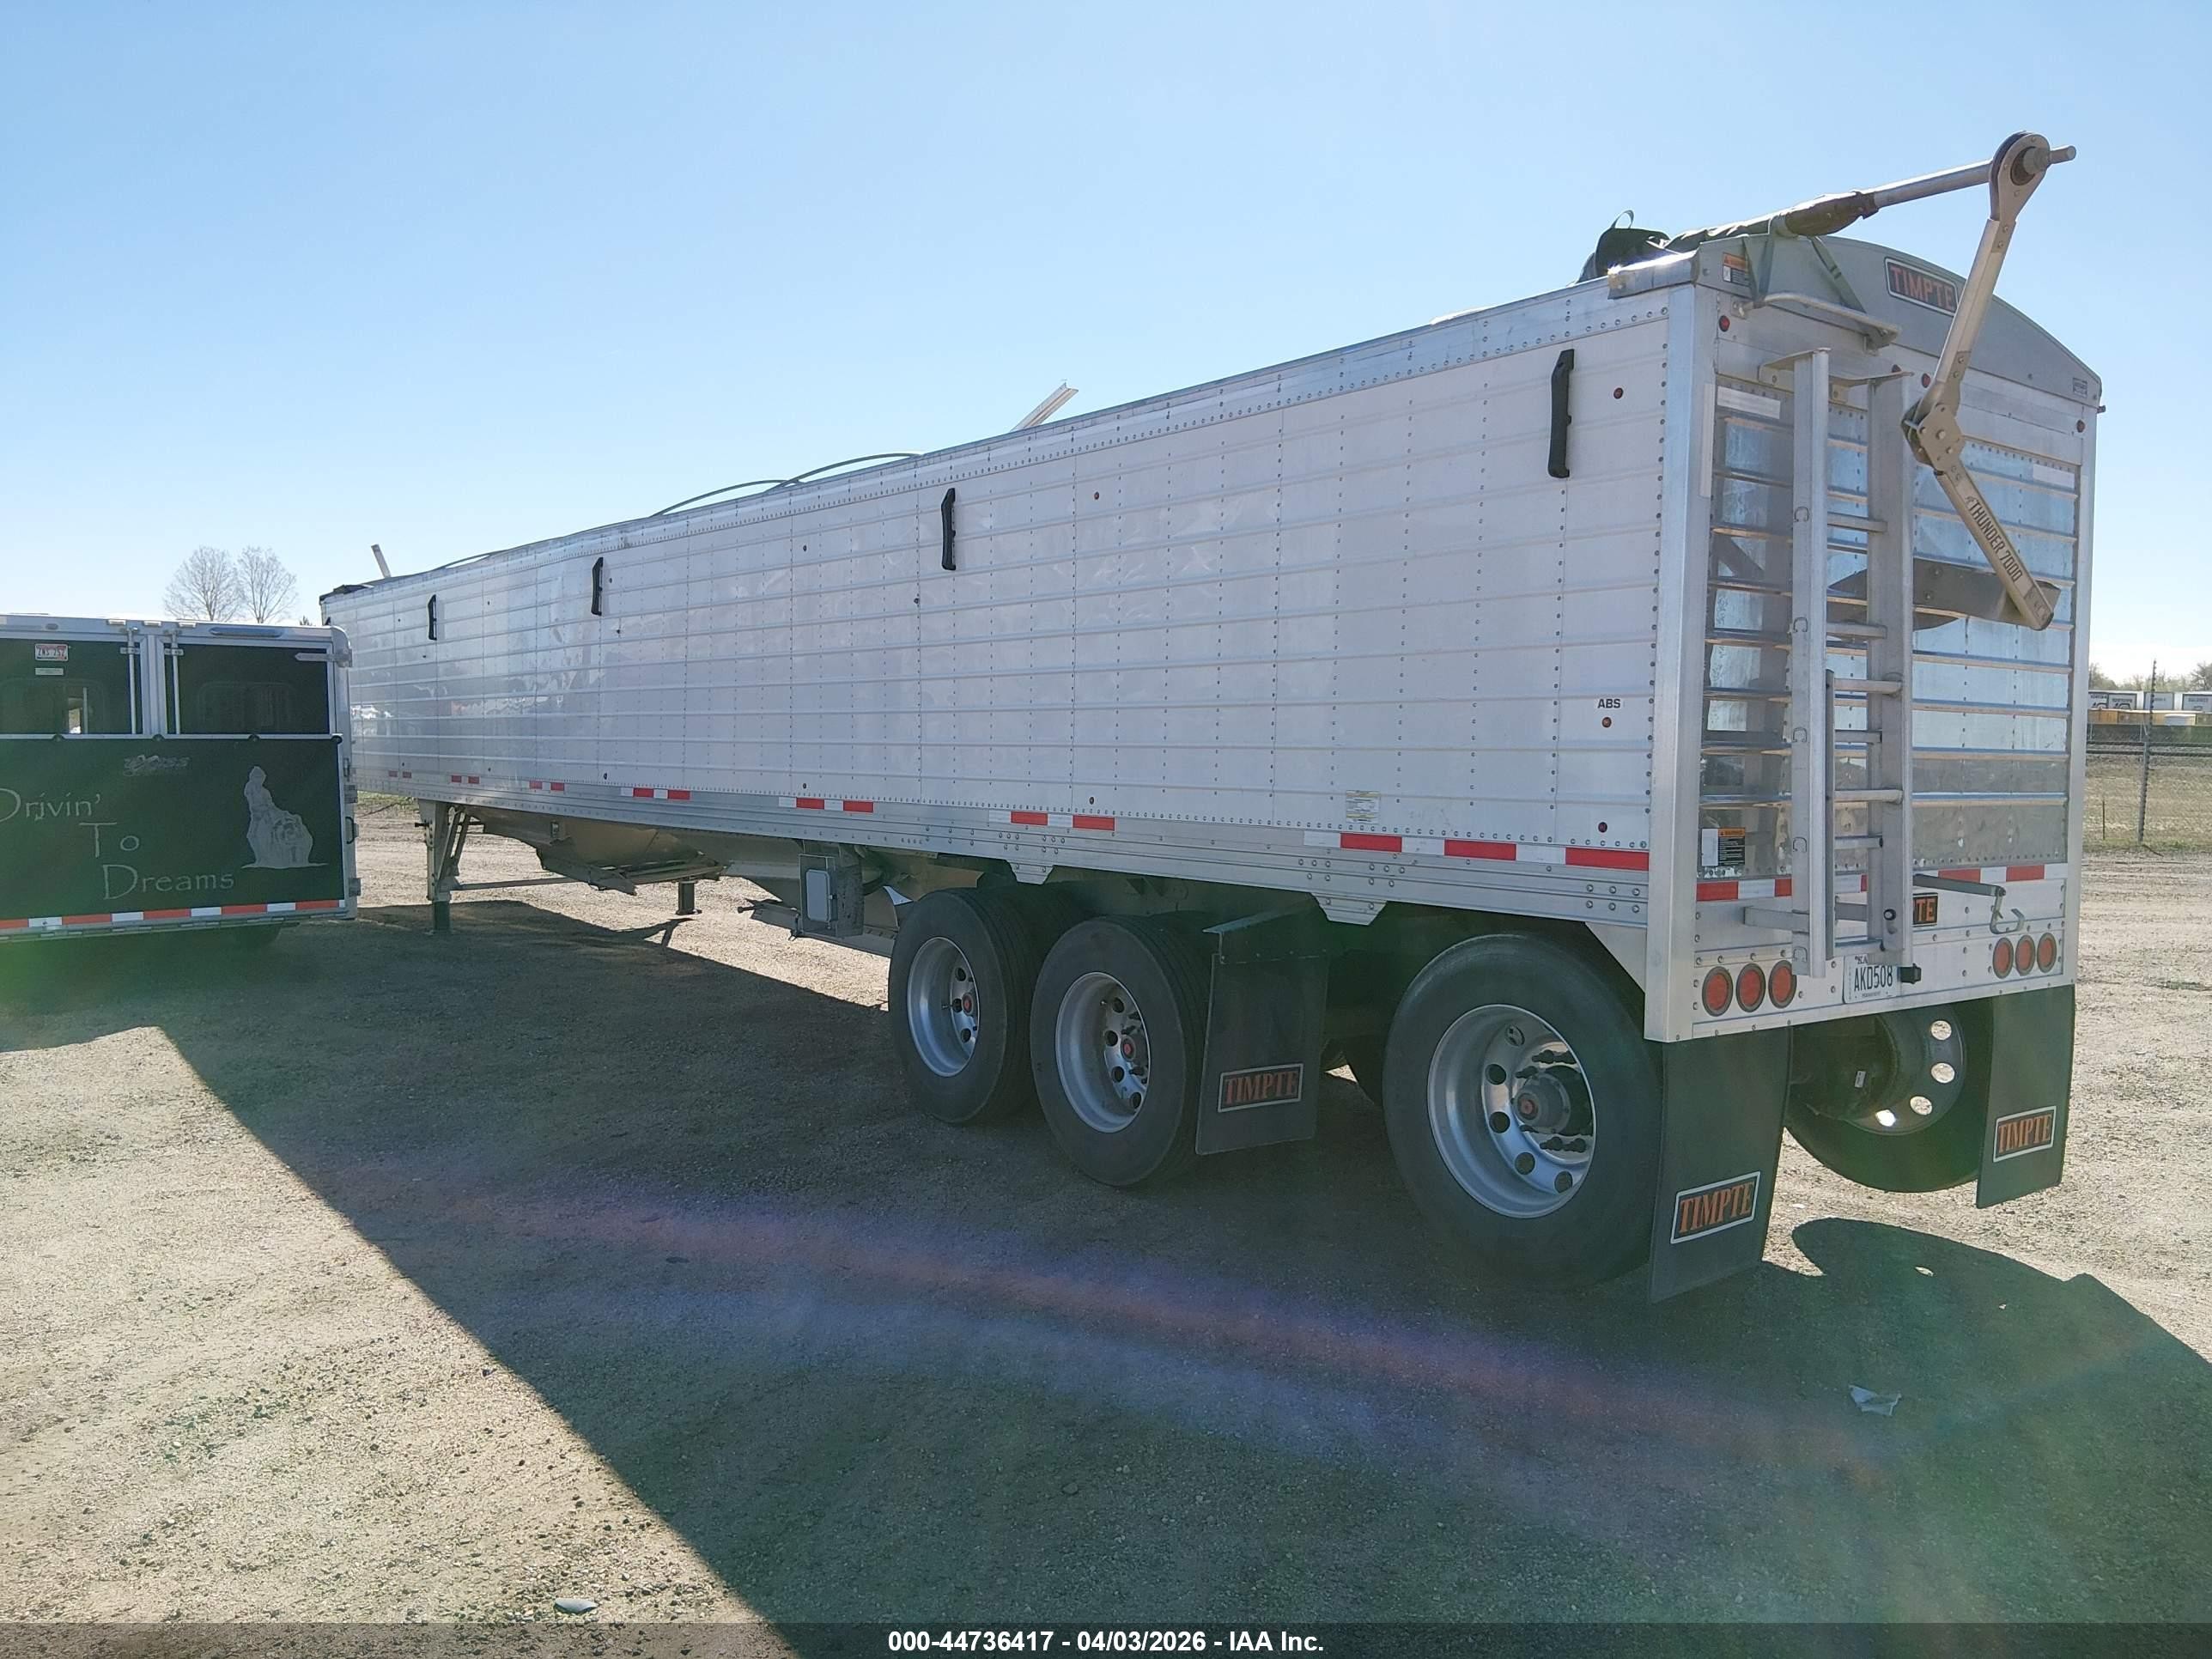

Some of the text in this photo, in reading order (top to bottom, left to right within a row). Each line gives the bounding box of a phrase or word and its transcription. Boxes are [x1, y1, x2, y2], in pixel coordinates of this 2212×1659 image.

[1890, 264, 1954, 311] TIMPTE
[1968, 499, 2023, 583] THUNDER 7000
[1597, 698, 1621, 708] ABS
[79, 822, 140, 859] To
[102, 864, 234, 900] Dreams
[1854, 965, 1893, 992] AKD508
[1224, 1071, 1299, 1106] TIMPTE
[1997, 1113, 2052, 1154] TIMPTE
[1678, 1181, 1755, 1234] TIMPTE
